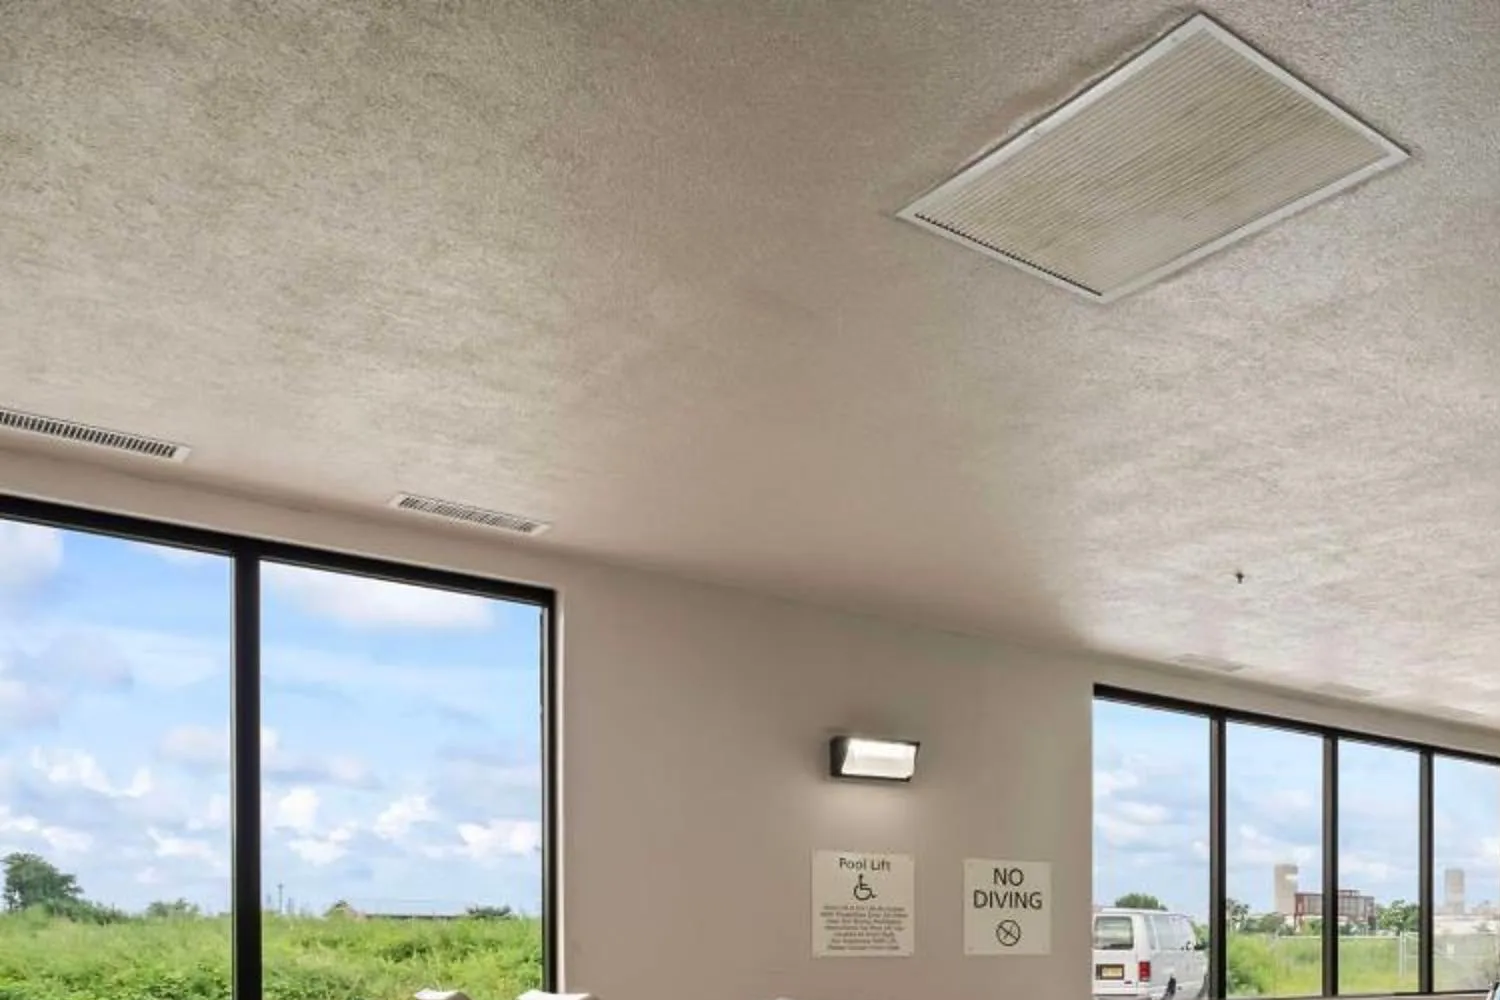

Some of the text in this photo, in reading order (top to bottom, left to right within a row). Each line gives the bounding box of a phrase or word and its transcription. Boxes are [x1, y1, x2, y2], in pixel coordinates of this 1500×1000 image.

[839, 857, 891, 871] Pool Lift
[993, 867, 1024, 886] NO
[973, 889, 1042, 910] DIVING
